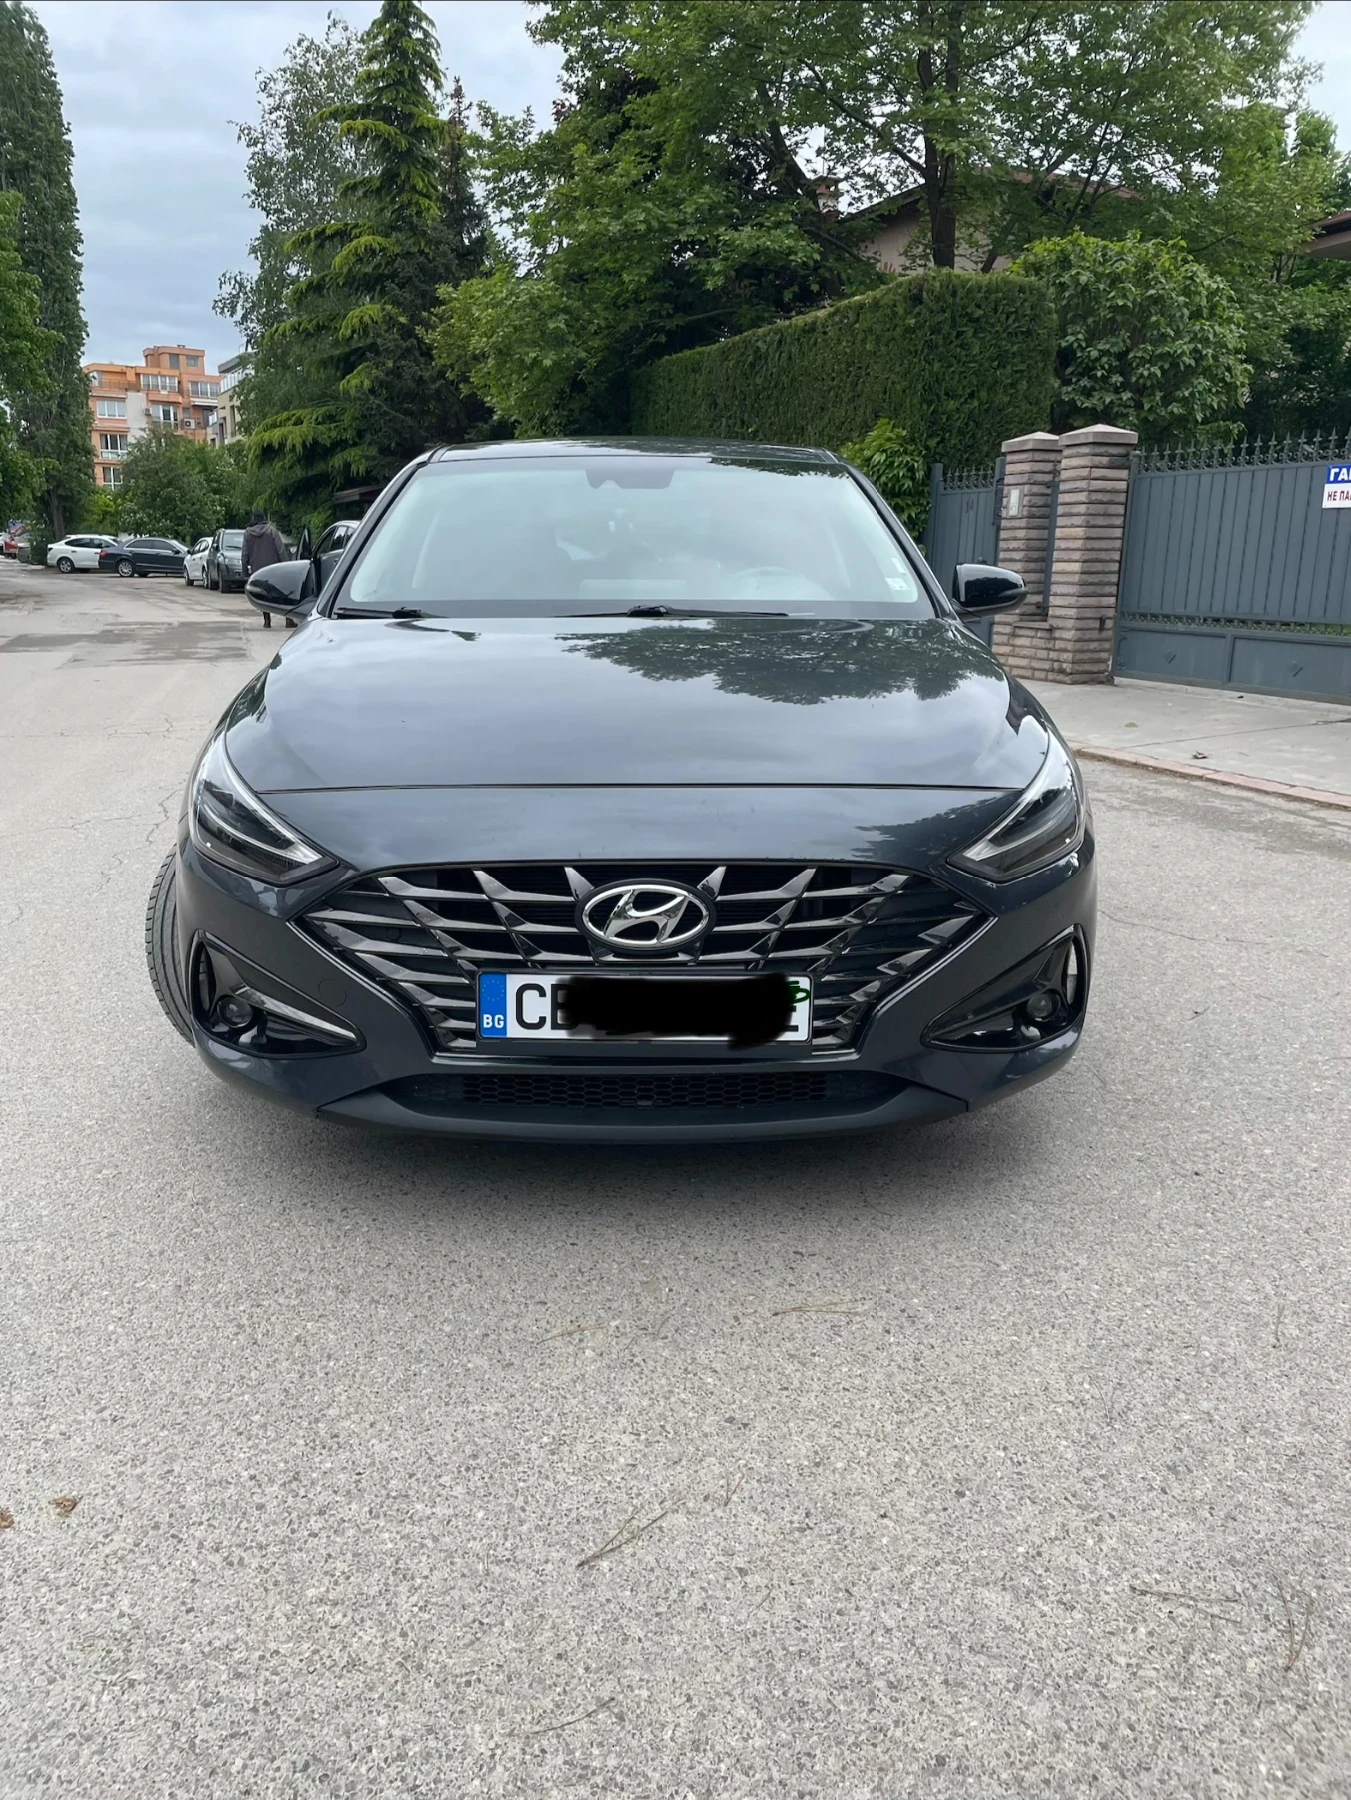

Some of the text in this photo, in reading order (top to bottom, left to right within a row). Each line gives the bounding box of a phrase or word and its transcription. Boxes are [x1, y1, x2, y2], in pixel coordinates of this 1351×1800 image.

[1329, 467, 1351, 481] ГА
[1327, 490, 1351, 501] НЕ ПА
[483, 1014, 504, 1029] BG
